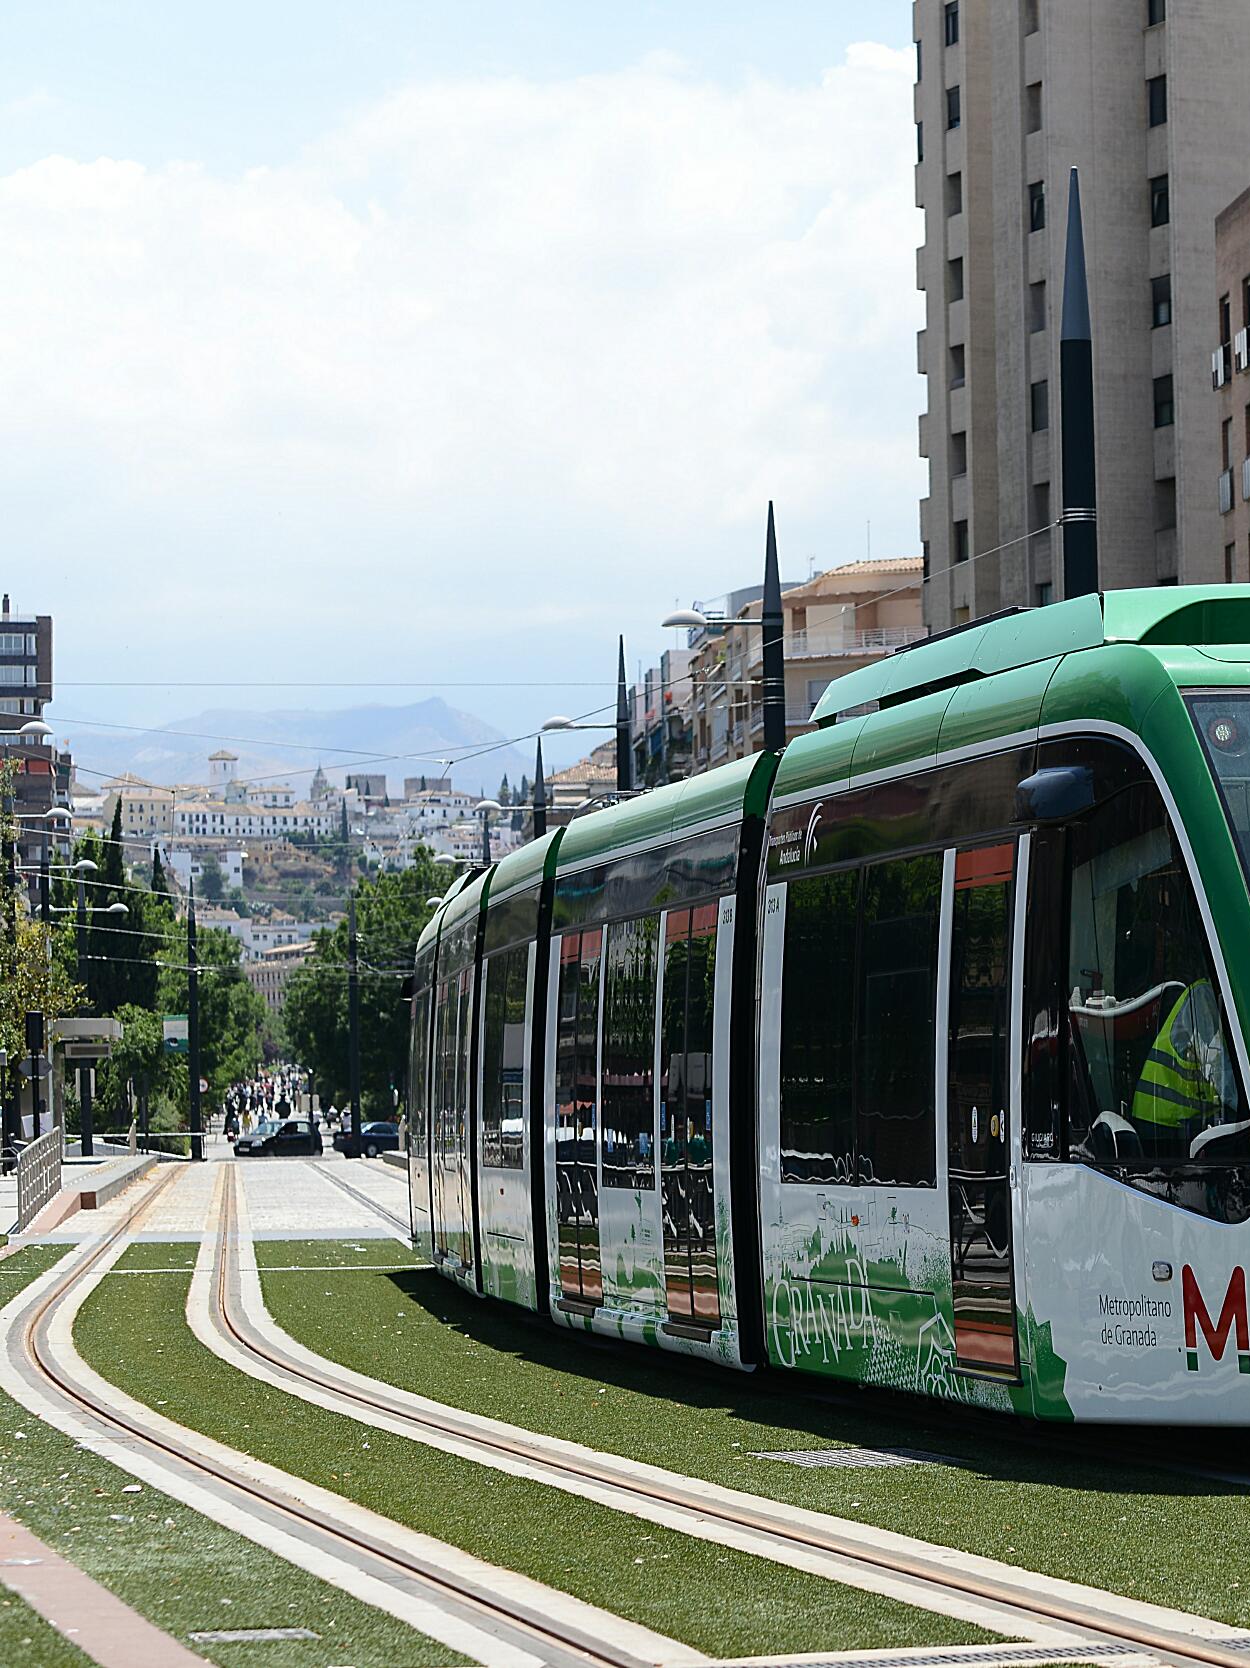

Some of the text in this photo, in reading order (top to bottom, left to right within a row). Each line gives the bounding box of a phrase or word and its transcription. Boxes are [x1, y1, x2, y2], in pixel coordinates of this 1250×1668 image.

[773, 1259, 882, 1368] GRANADA
[1099, 1294, 1172, 1321] Metropolitano
[1101, 1322, 1157, 1347] de Granada
